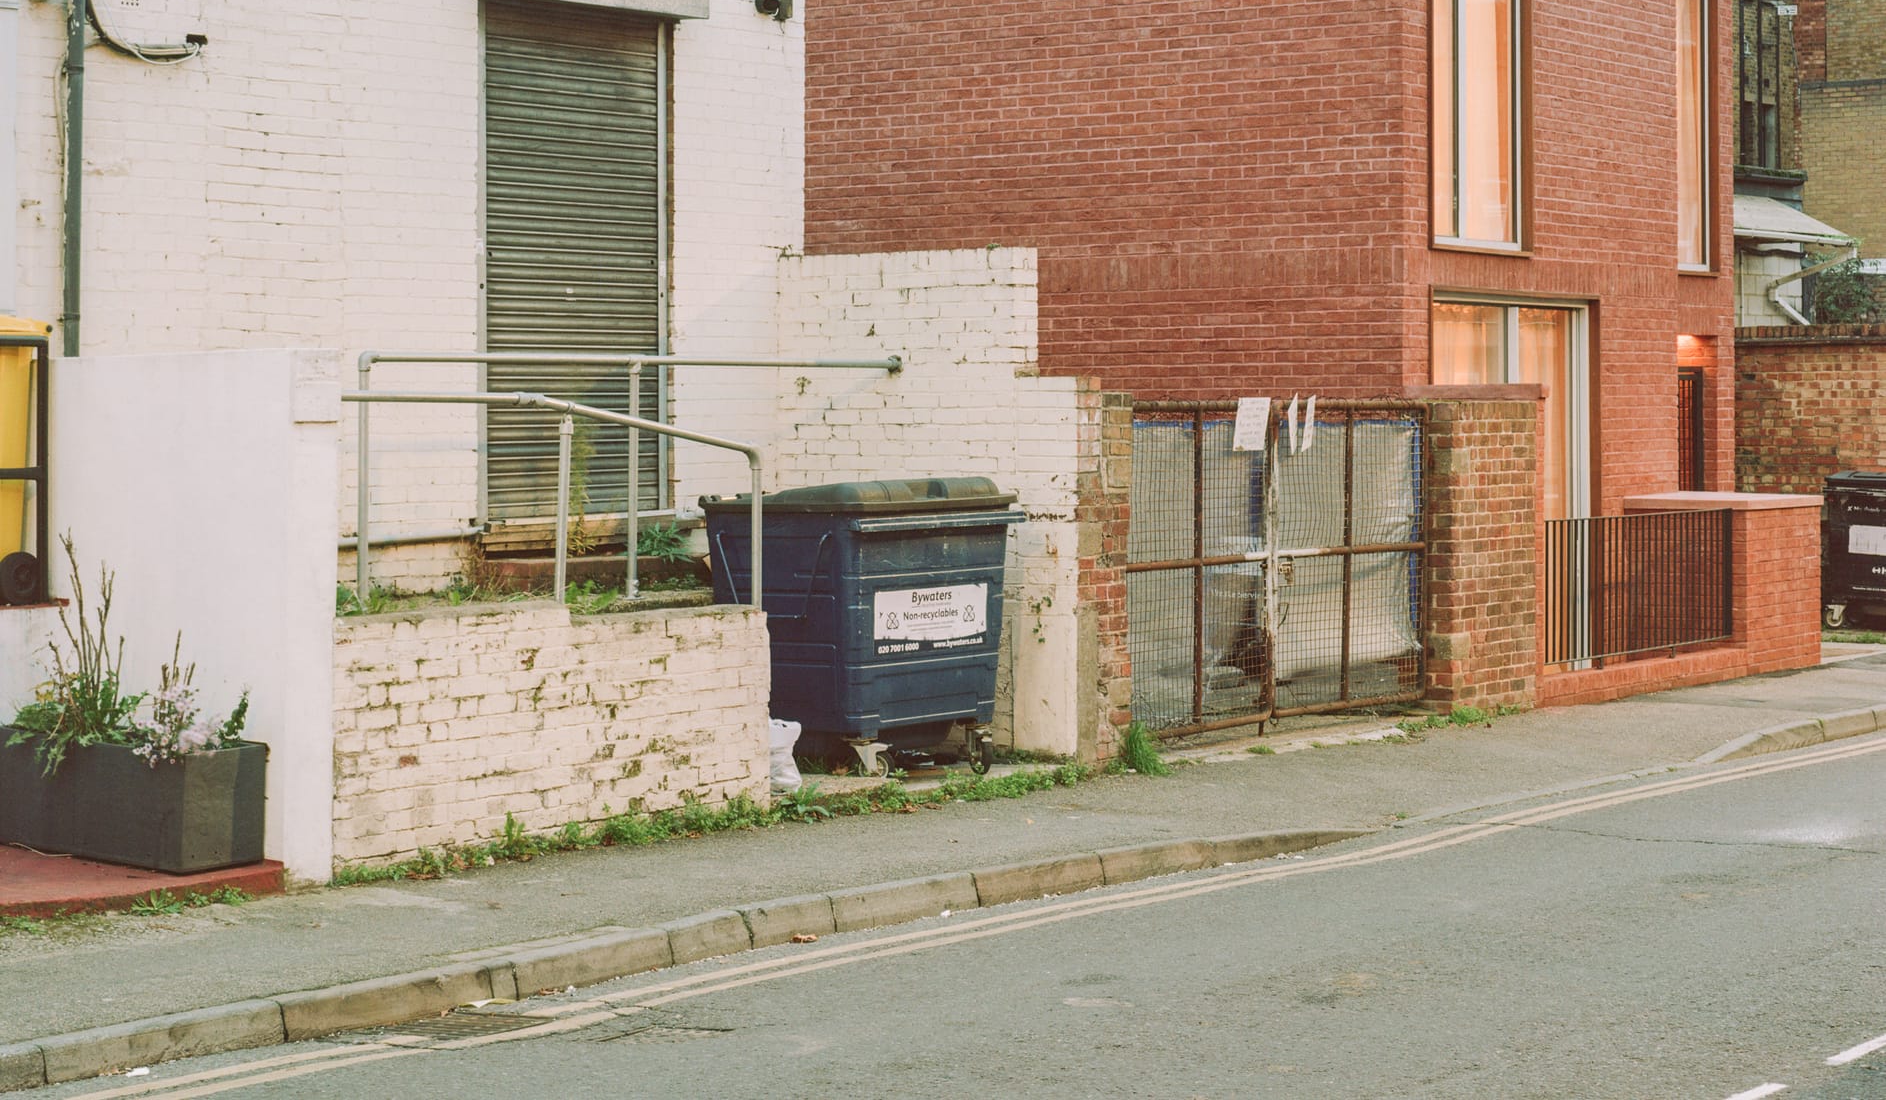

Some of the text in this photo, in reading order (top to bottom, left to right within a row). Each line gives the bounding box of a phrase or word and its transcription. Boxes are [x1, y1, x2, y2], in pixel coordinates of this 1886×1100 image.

[911, 591, 952, 605] Bywaters
[903, 607, 959, 620] Non-recyclables
[878, 642, 919, 654] 020 7001 6000
